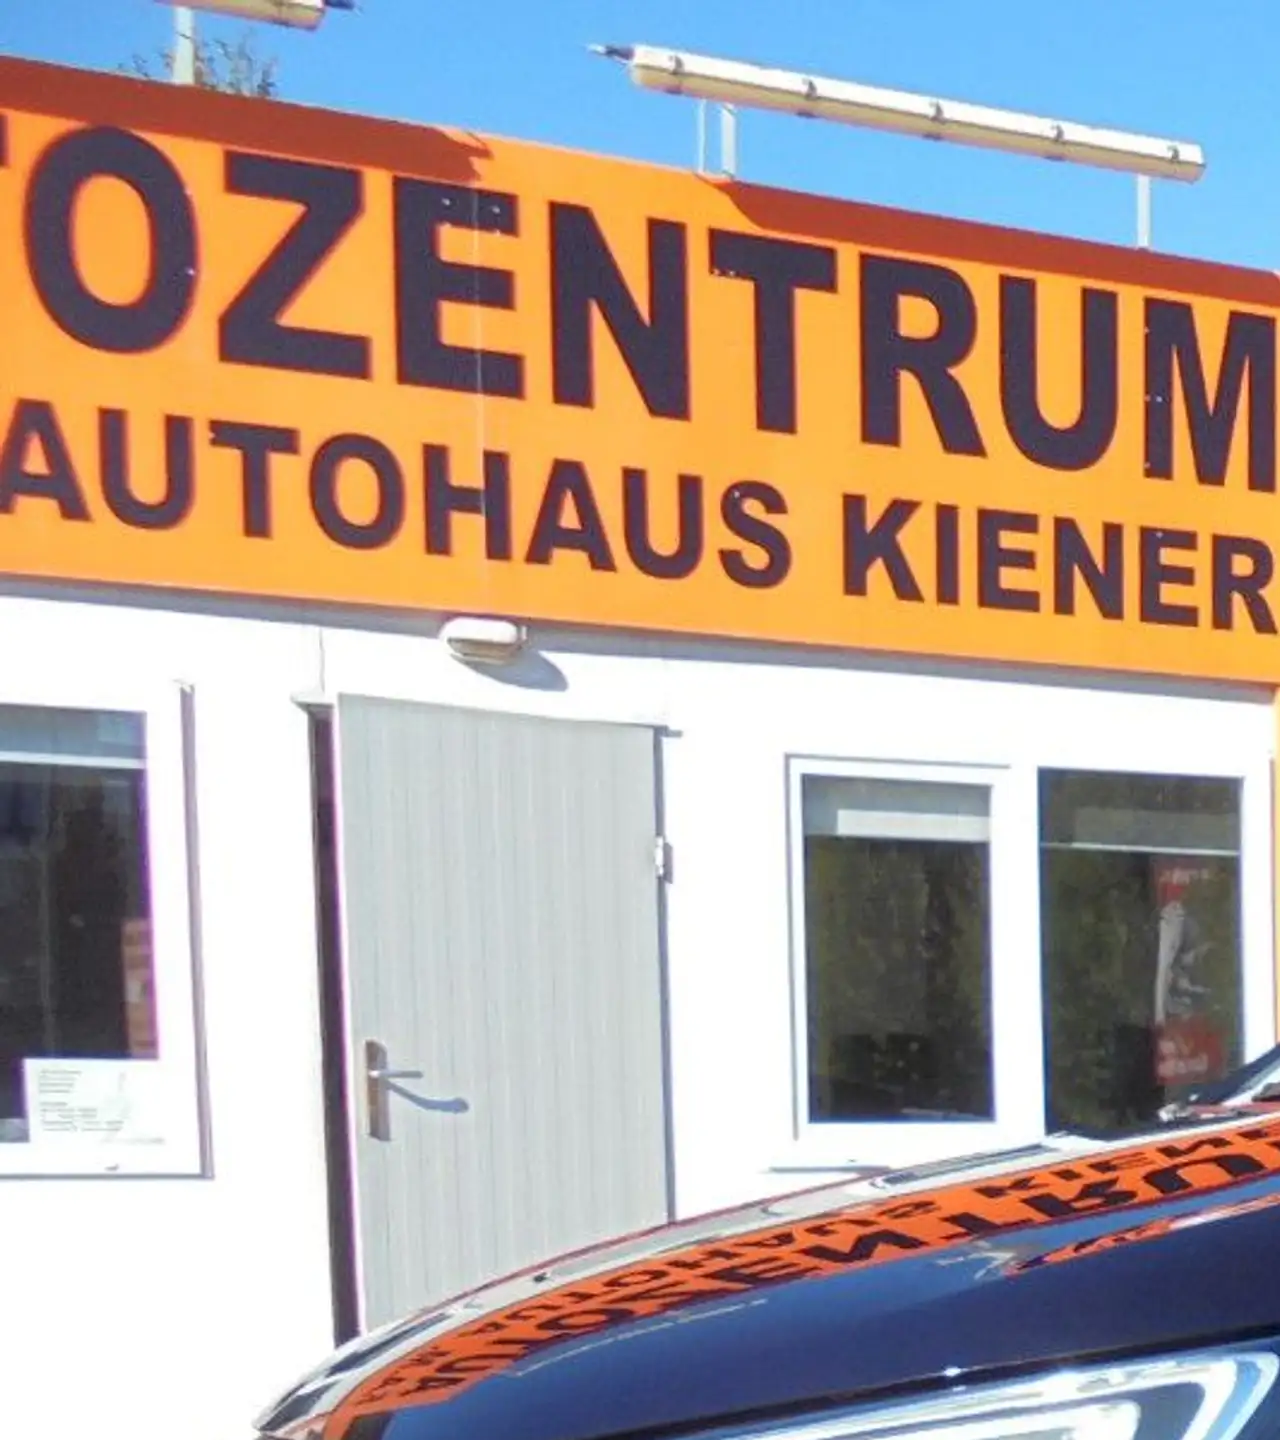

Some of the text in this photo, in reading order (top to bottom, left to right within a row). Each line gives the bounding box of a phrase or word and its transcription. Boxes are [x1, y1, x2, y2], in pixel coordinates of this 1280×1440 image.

[0, 113, 1279, 495] OZENTRUM
[0, 397, 1279, 636] AUTOHAUS KIENER
